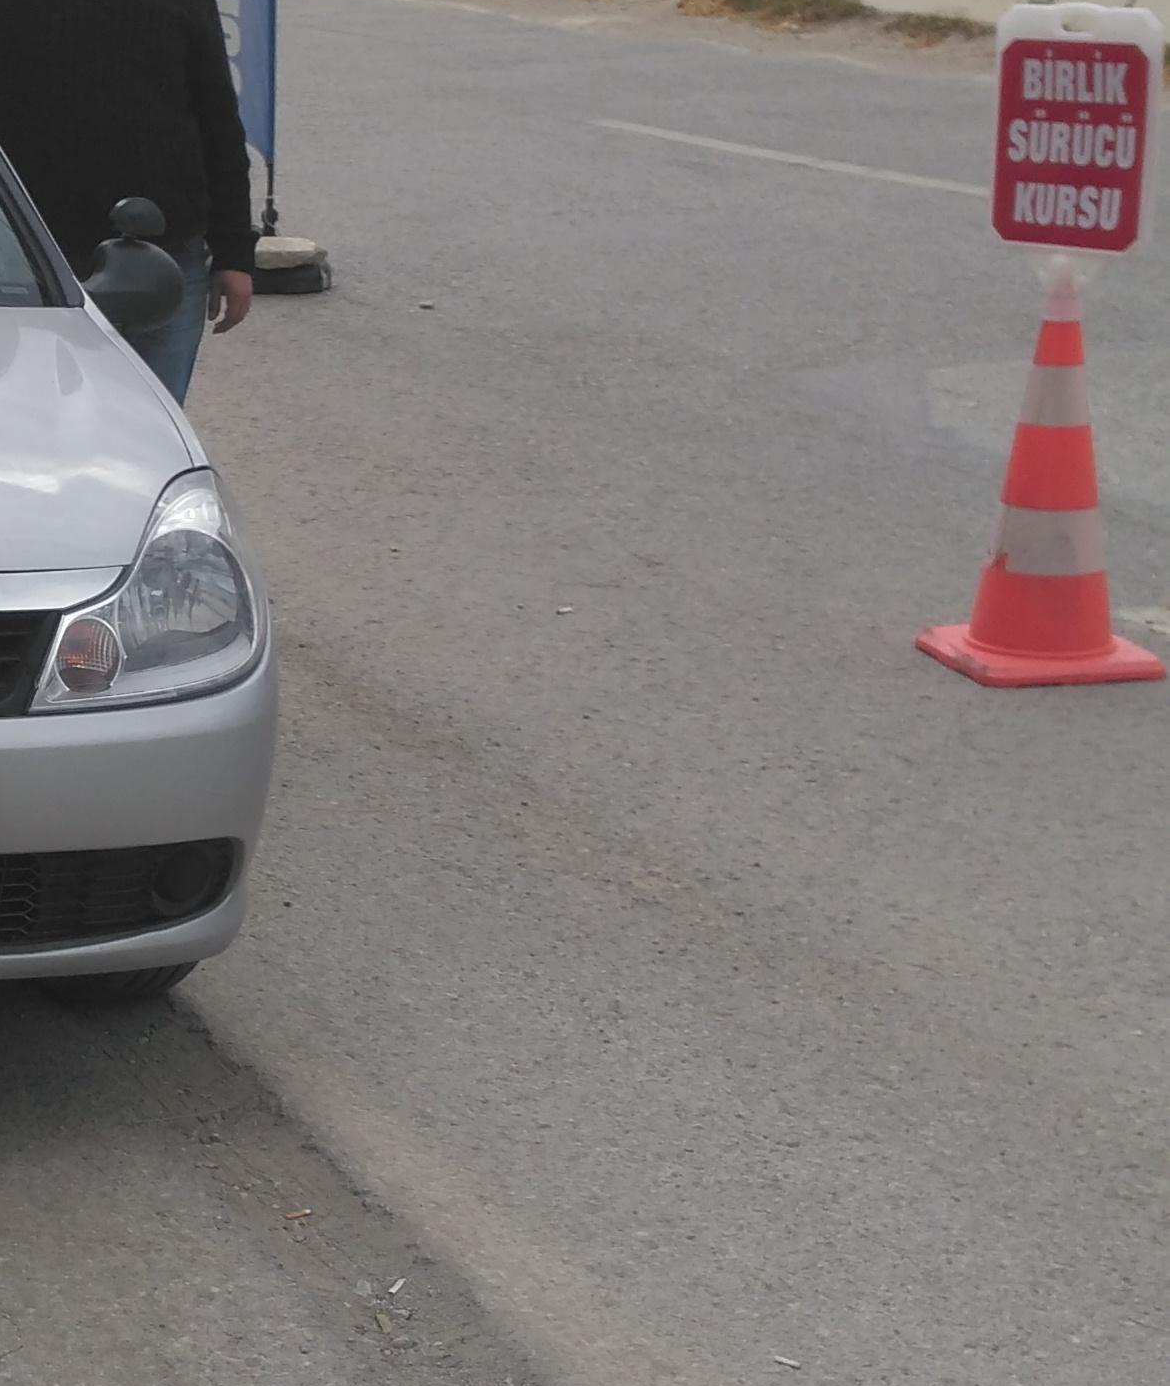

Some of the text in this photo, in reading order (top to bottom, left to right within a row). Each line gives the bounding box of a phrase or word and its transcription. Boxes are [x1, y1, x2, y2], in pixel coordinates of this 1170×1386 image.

[1022, 49, 1129, 105] BİRLİK
[1007, 109, 1136, 170] SÜRÜCÜ
[1013, 181, 1122, 231] KURSU
